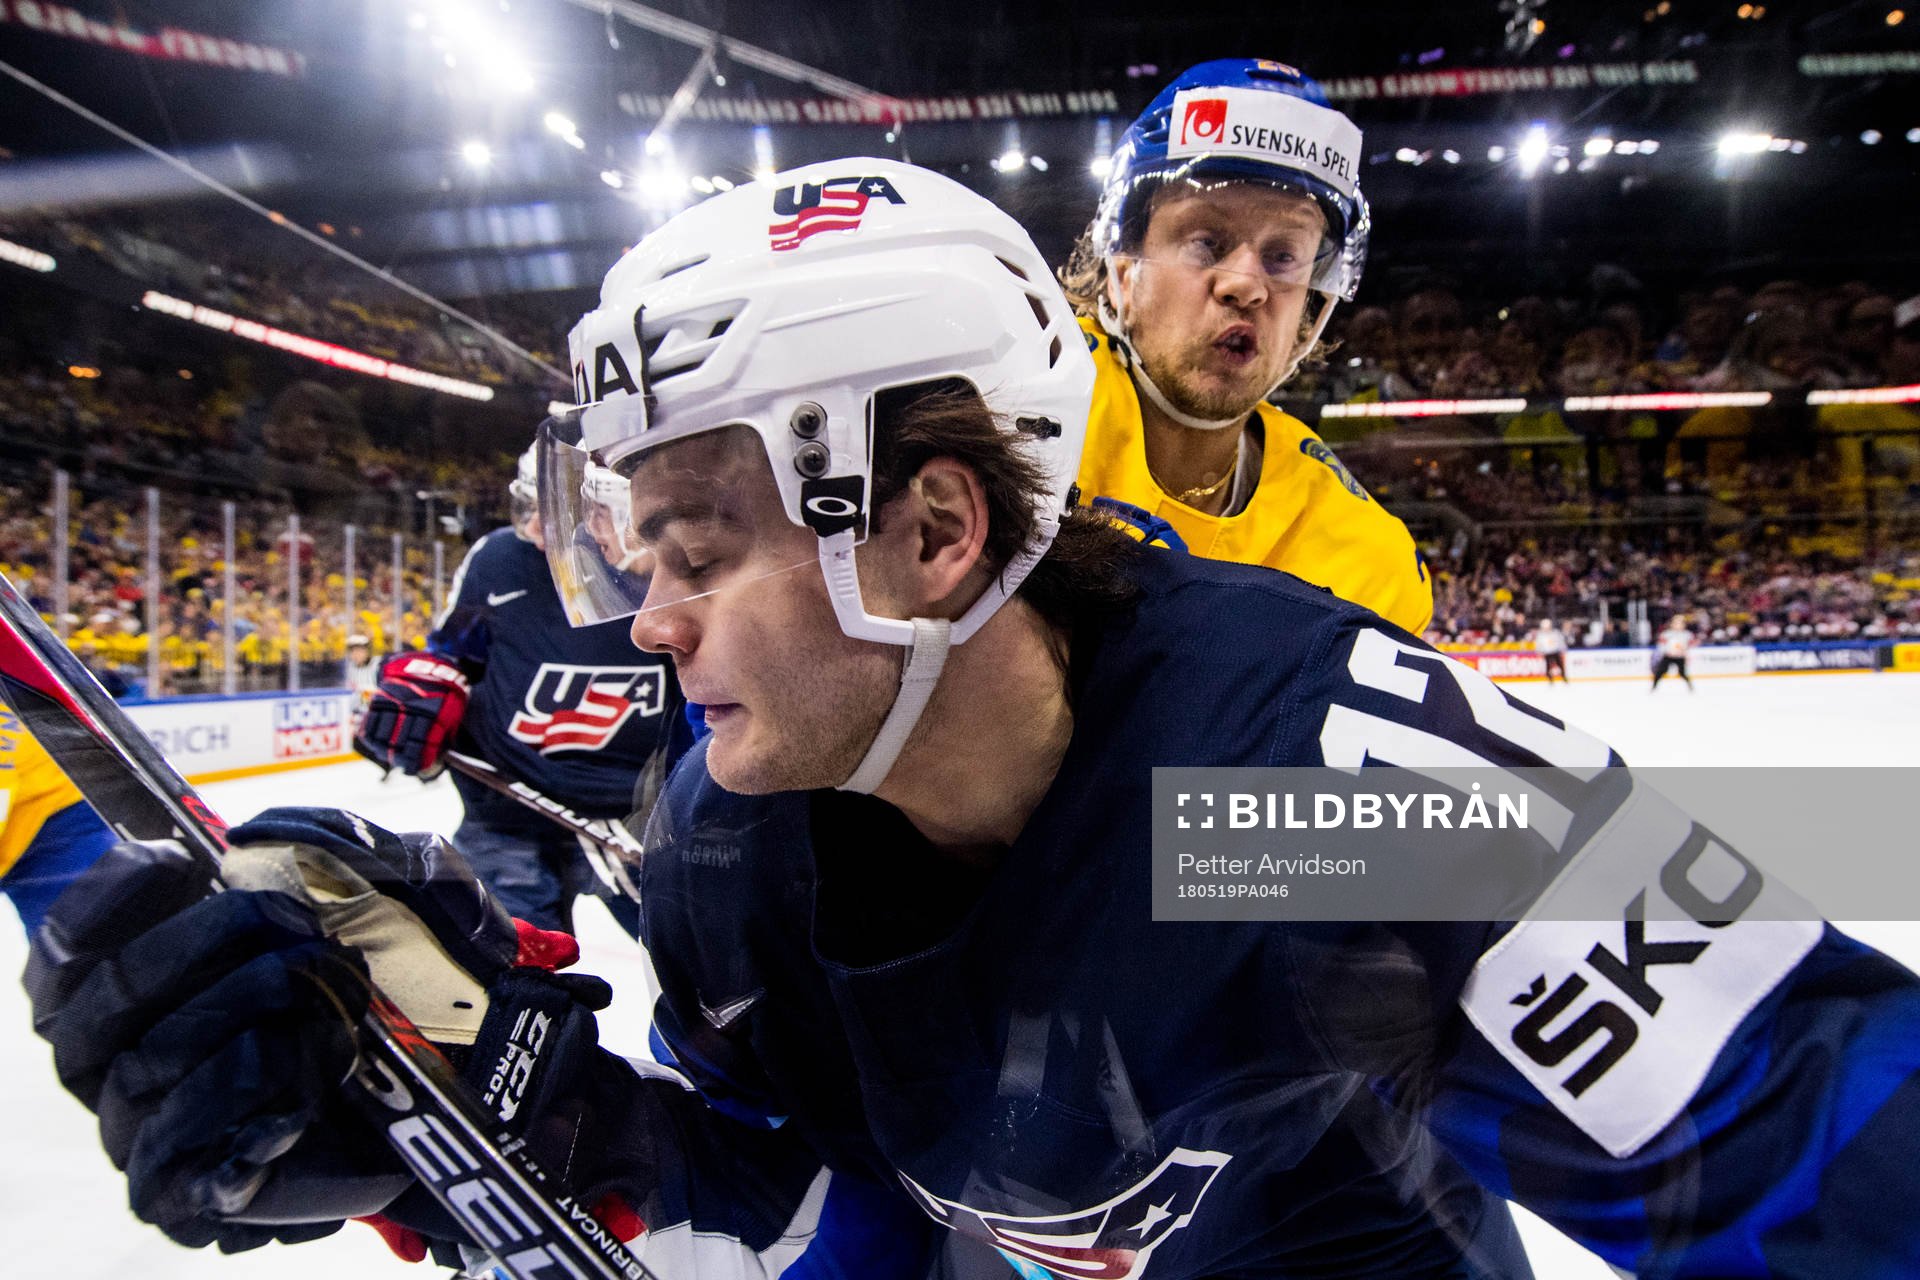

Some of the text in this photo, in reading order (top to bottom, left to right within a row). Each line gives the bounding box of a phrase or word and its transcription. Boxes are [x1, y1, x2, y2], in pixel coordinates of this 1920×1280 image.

[1231, 125, 1351, 182] SVENSKA SPEL
[769, 176, 906, 251] USA
[509, 662, 666, 755] USA
